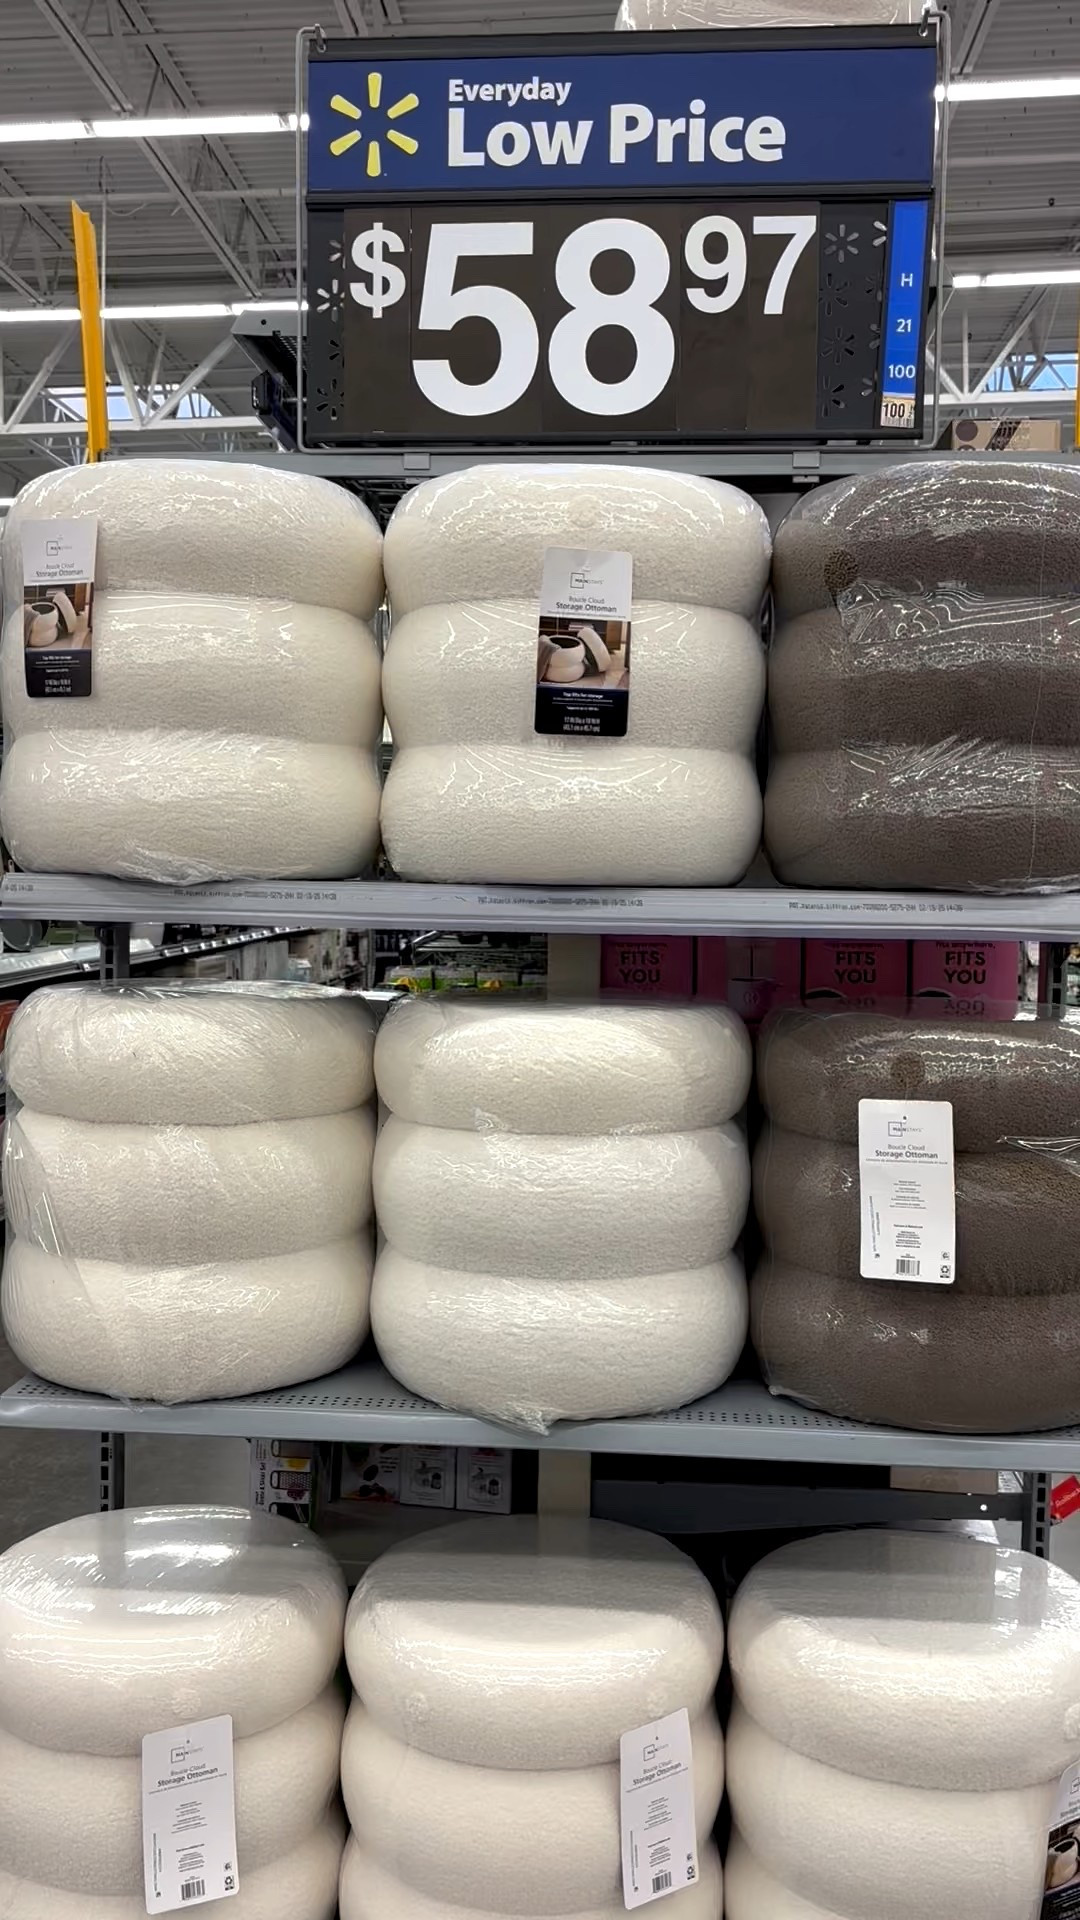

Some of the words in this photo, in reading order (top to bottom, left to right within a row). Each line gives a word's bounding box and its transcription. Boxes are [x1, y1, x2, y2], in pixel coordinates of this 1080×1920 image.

[448, 76, 572, 106] Everyday
[448, 107, 594, 167] Low
[609, 98, 787, 164] Price
[900, 272, 913, 287] H
[896, 318, 912, 333] 21
[888, 364, 916, 379] 100
[883, 402, 906, 418] 100
[556, 601, 583, 611] Storage
[584, 603, 617, 612] Ottoman
[620, 949, 660, 965] FITS
[836, 950, 876, 966] FITS
[945, 950, 986, 966] FITS
[618, 968, 661, 985] YOU
[834, 968, 877, 985] YOU
[943, 968, 987, 985] YOU
[875, 1149, 904, 1160] Storage
[904, 1150, 939, 1159] Ottoman
[907, 1144, 926, 1152] Cloud
[157, 1775, 186, 1788] Storage
[186, 1767, 219, 1780] Ottoman
